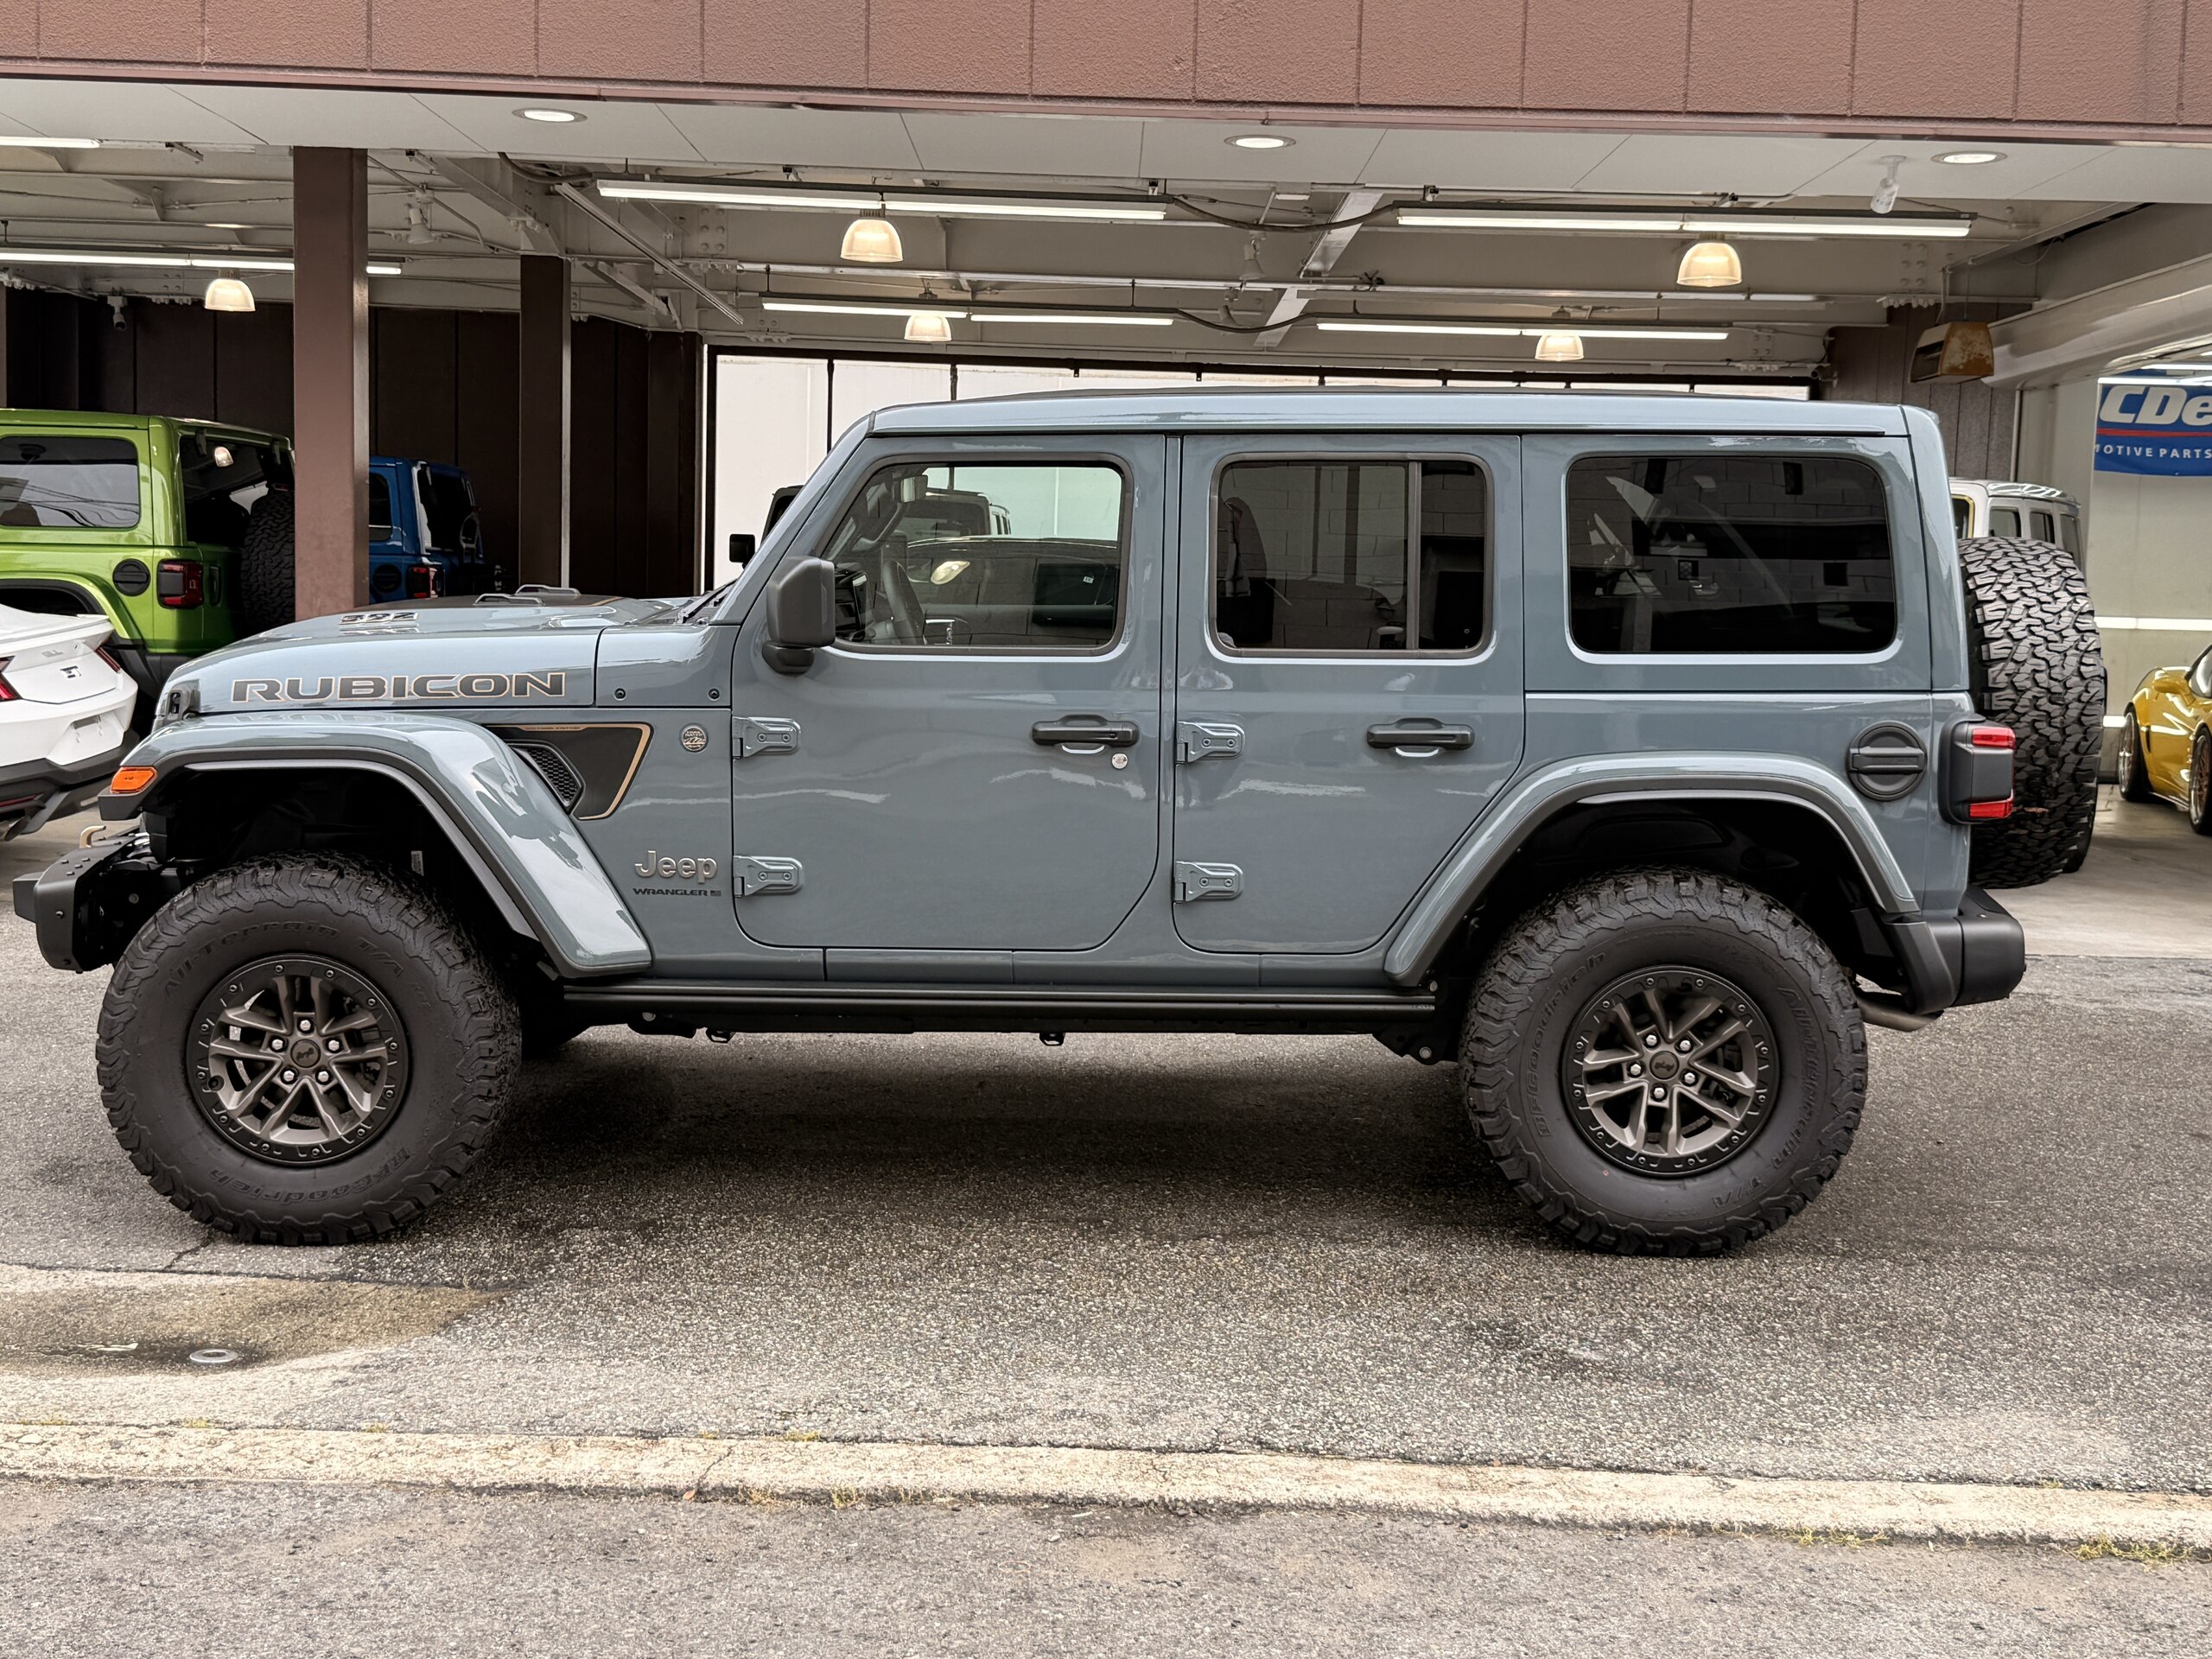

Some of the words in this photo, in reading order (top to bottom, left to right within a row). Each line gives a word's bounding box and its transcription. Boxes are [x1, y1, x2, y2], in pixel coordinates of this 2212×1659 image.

[2160, 448, 2212, 459] PARTS
[231, 672, 567, 702] RUBICON
[634, 850, 717, 885] Jeep
[632, 887, 709, 897] WRANGLER
[1526, 951, 1606, 1138] BFGoodrich
